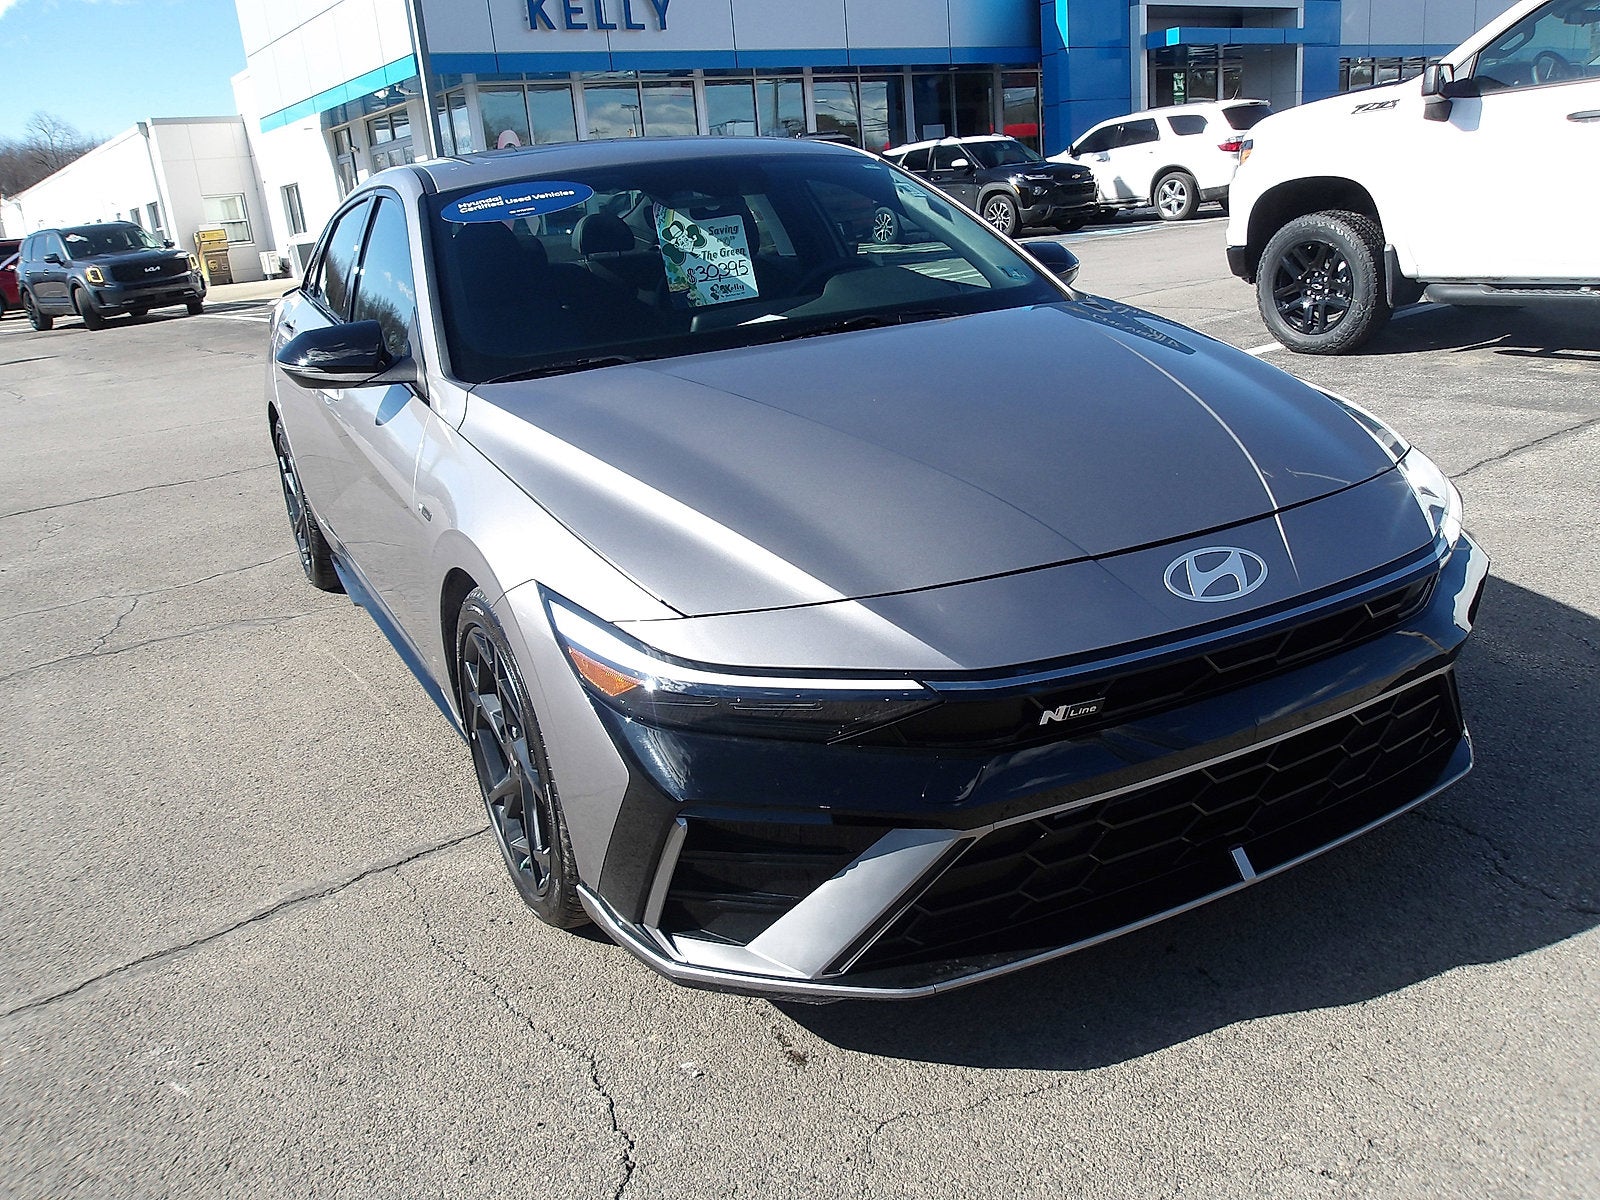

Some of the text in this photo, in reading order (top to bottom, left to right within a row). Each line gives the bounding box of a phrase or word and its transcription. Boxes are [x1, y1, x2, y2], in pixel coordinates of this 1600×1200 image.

[526, 0, 671, 31] KELLY
[458, 196, 502, 208] Hyundai
[460, 201, 504, 213] Certified
[505, 196, 531, 204] Used
[532, 190, 575, 199] Vehicles
[708, 224, 739, 236] Saving
[700, 248, 746, 261] The Green
[1069, 705, 1097, 717] Line
